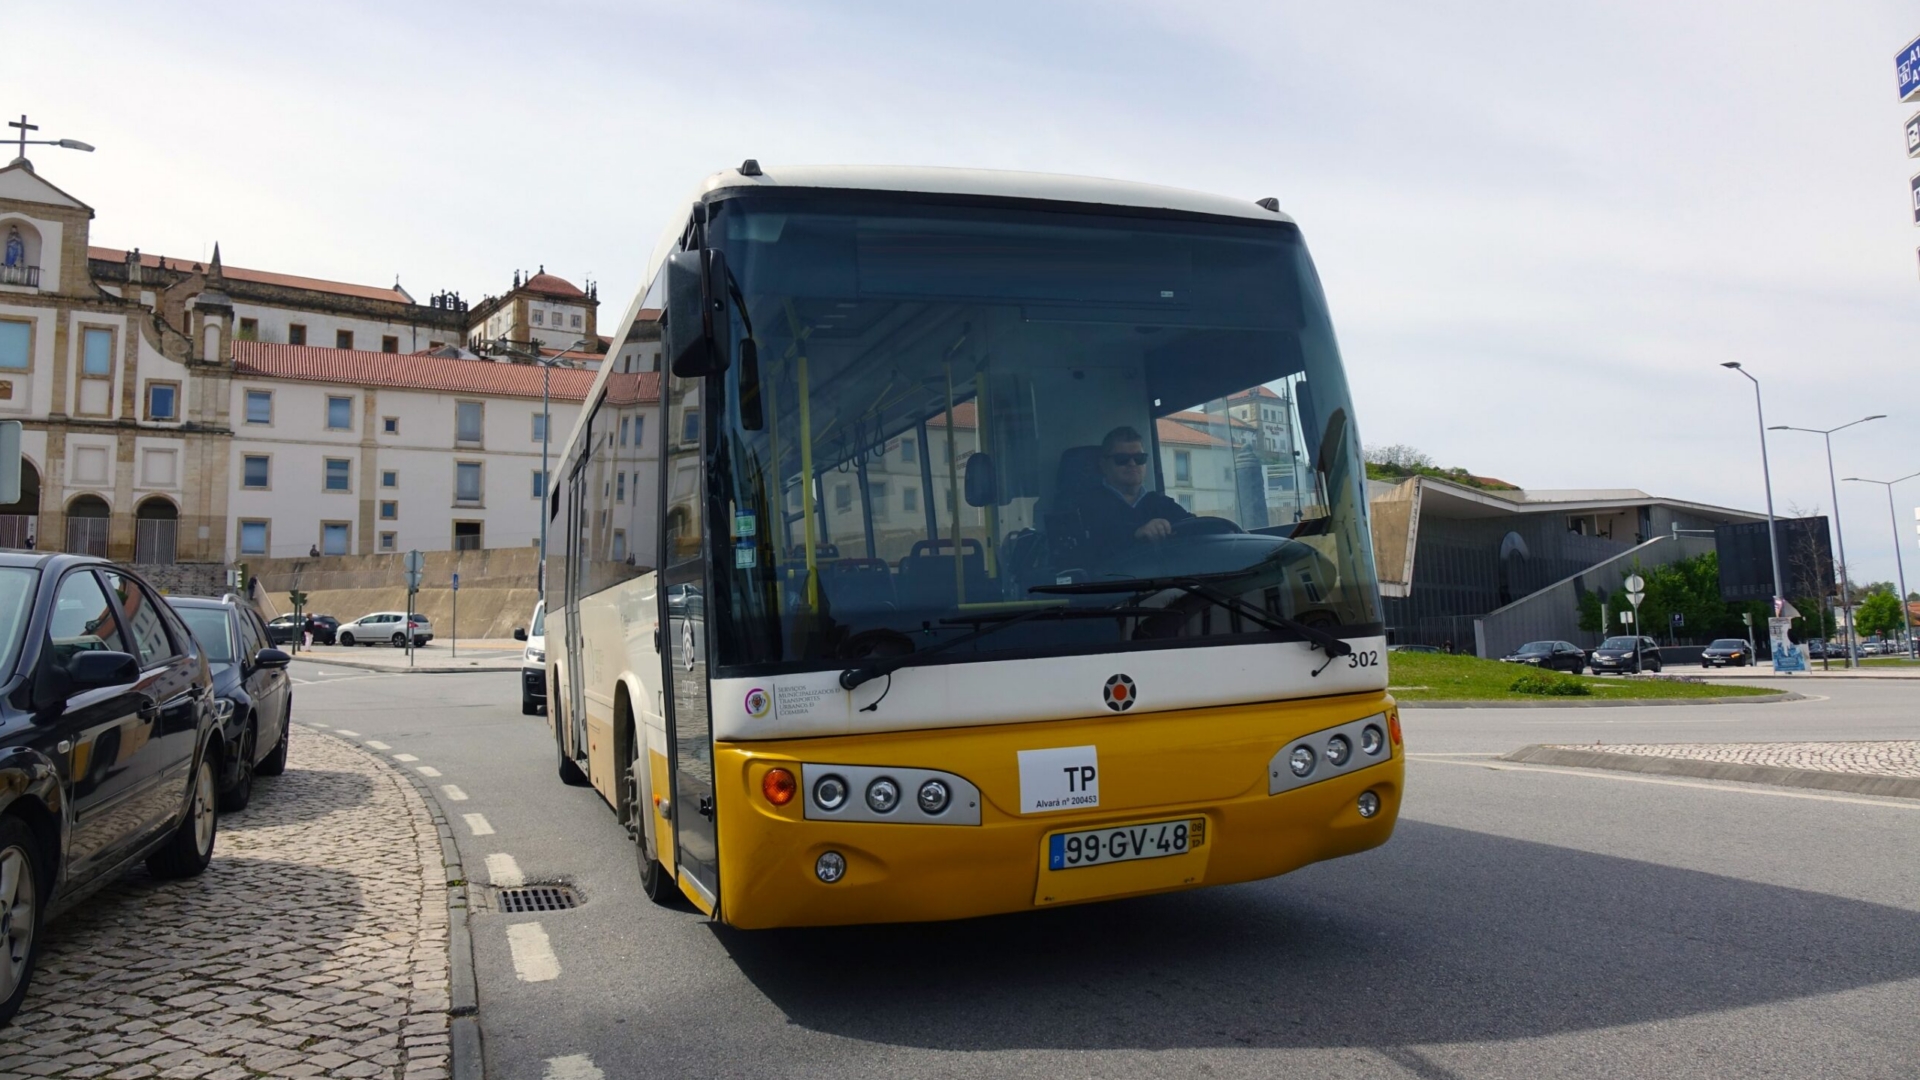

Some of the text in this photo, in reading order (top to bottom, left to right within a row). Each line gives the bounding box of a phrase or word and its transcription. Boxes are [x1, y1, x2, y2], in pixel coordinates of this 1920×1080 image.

[1348, 650, 1378, 668] 302
[778, 688, 834, 699] MUNICIPALIZADOS
[779, 696, 821, 704] TRANSPORTES
[1063, 765, 1096, 792] TP
[1036, 798, 1060, 808] Alvará
[1071, 795, 1097, 805] 200453
[1054, 856, 1061, 864] P
